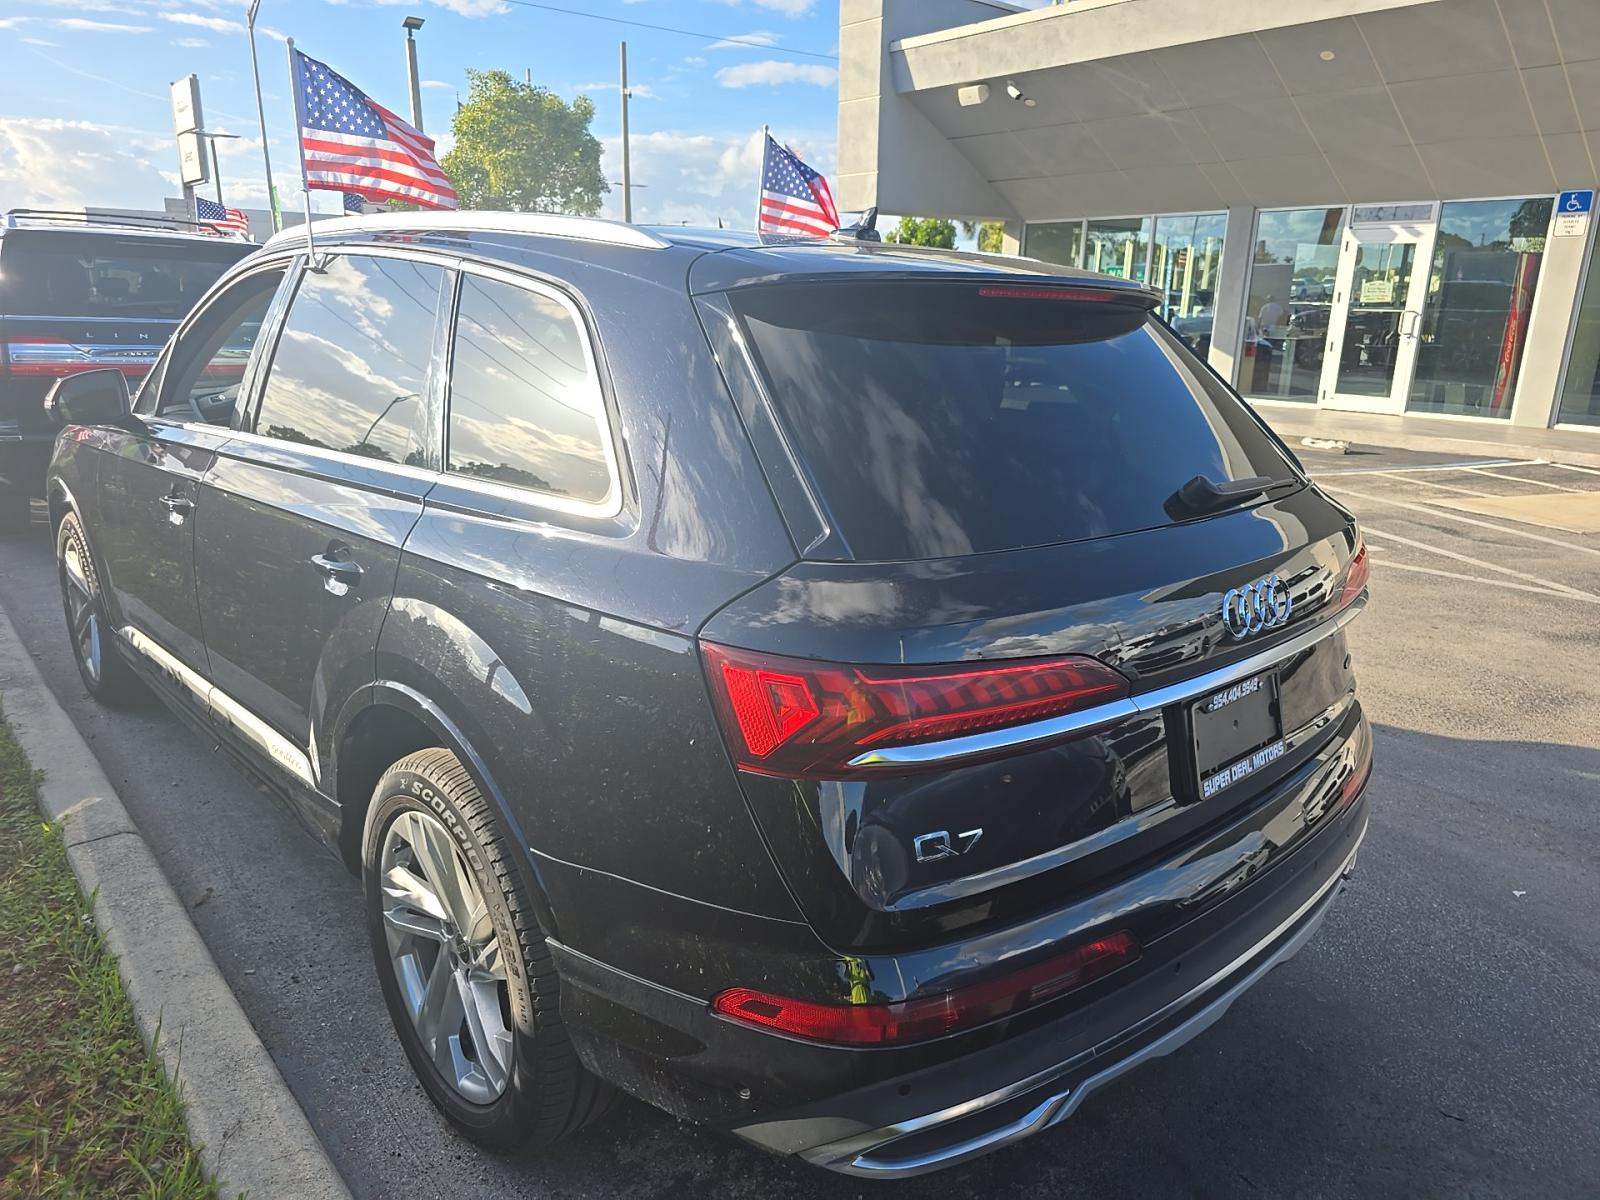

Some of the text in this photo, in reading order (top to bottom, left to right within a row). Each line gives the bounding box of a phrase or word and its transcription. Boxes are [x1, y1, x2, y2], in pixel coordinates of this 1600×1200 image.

[1203, 741, 1284, 798] SUPER DEAL MOTORS
[411, 781, 495, 894] SCORPION
[913, 827, 983, 864] Q7
